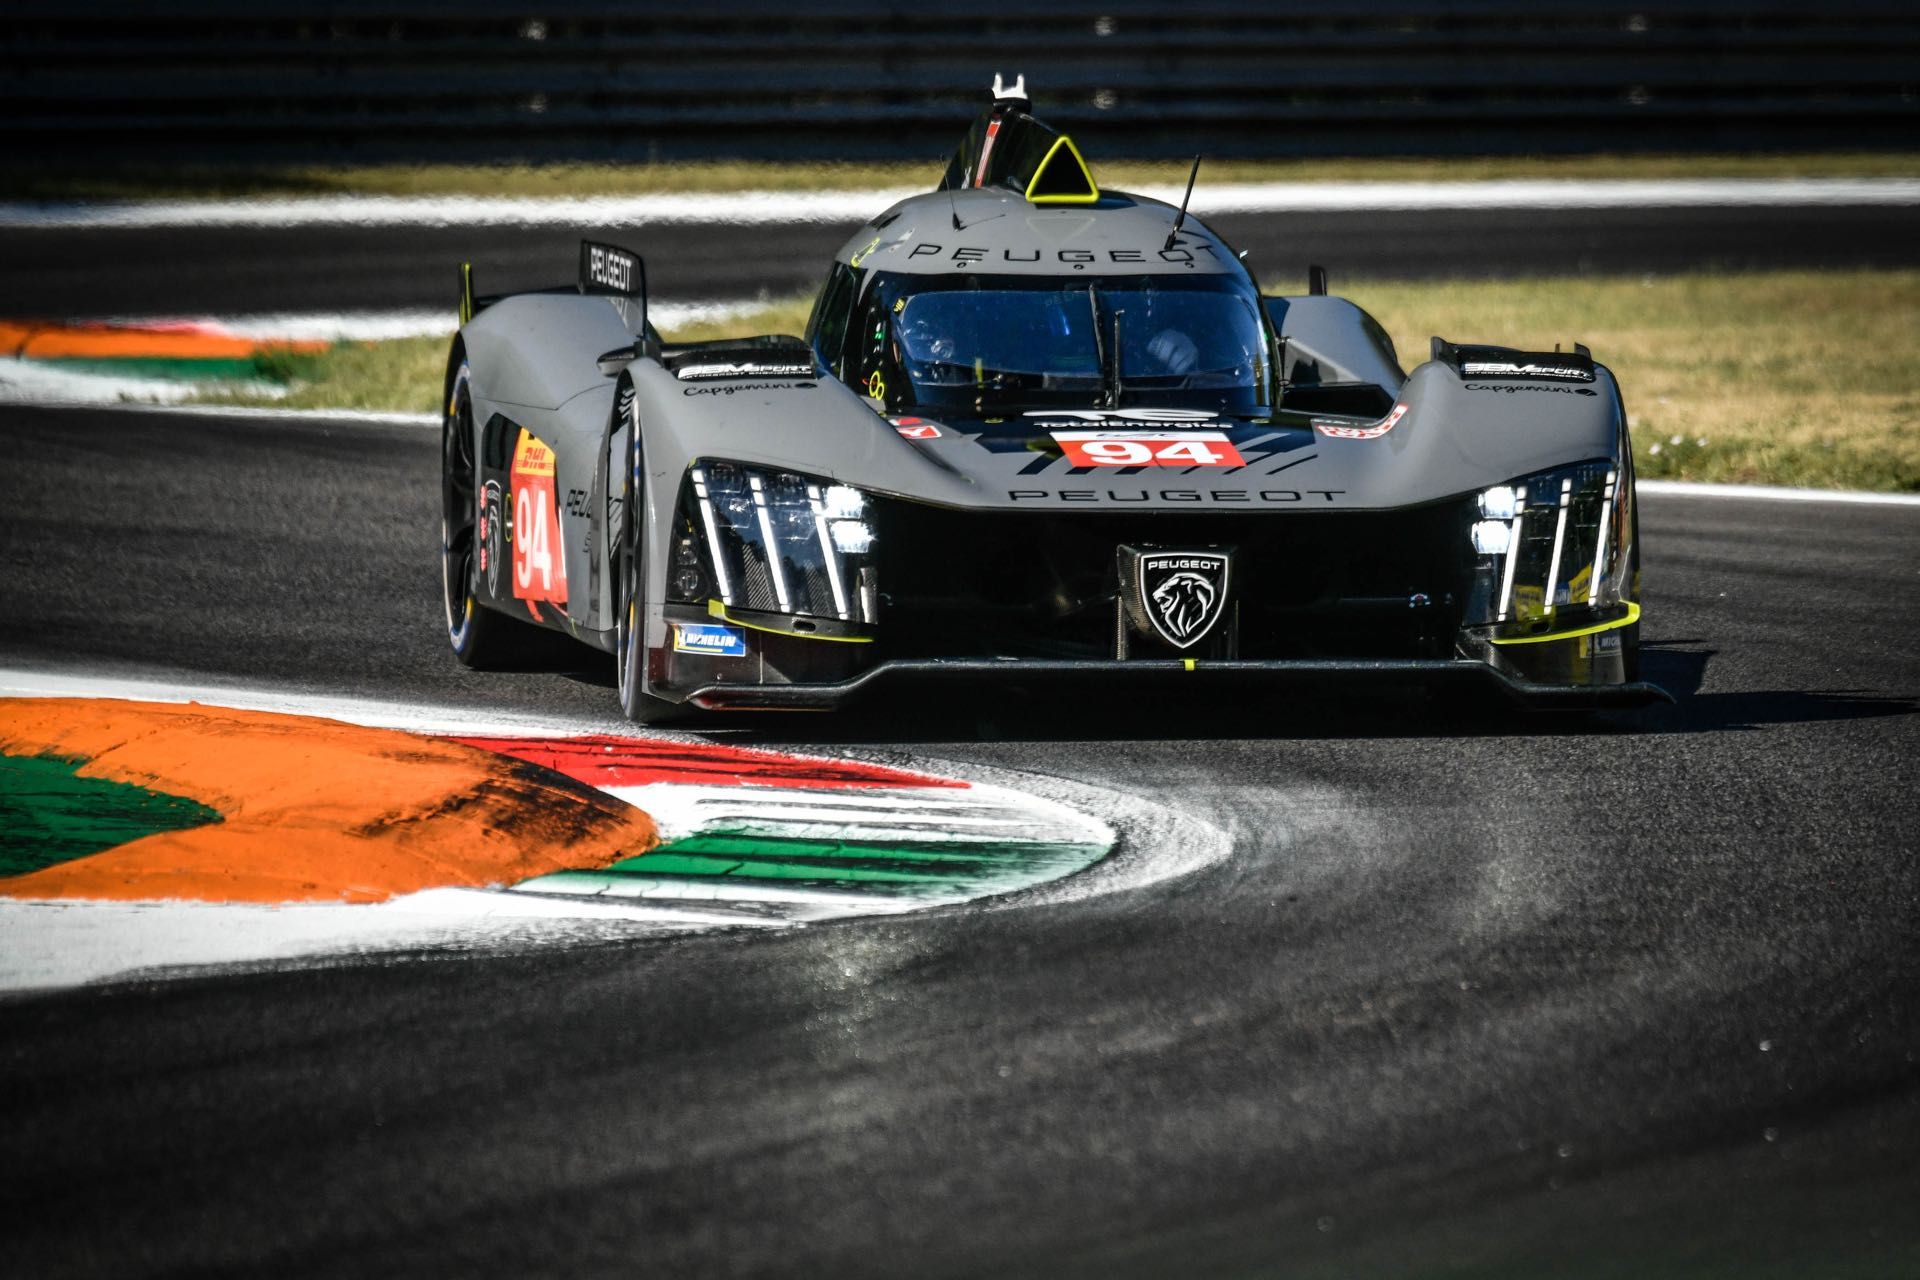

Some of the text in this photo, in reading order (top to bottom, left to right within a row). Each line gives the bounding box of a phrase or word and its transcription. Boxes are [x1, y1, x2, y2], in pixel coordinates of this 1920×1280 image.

[908, 243, 1219, 263] PEUGEOT
[591, 247, 632, 292] PEUGEOT
[683, 383, 792, 396] Capgemini
[1464, 383, 1574, 394] Capgemini
[1034, 420, 1233, 428] TotalEnergies
[1080, 441, 1224, 464] 94
[1008, 490, 1347, 502] PEUGEOT
[517, 487, 552, 590] 94
[1148, 560, 1220, 570] PEUGEOT
[686, 633, 736, 647] MICHELIN
